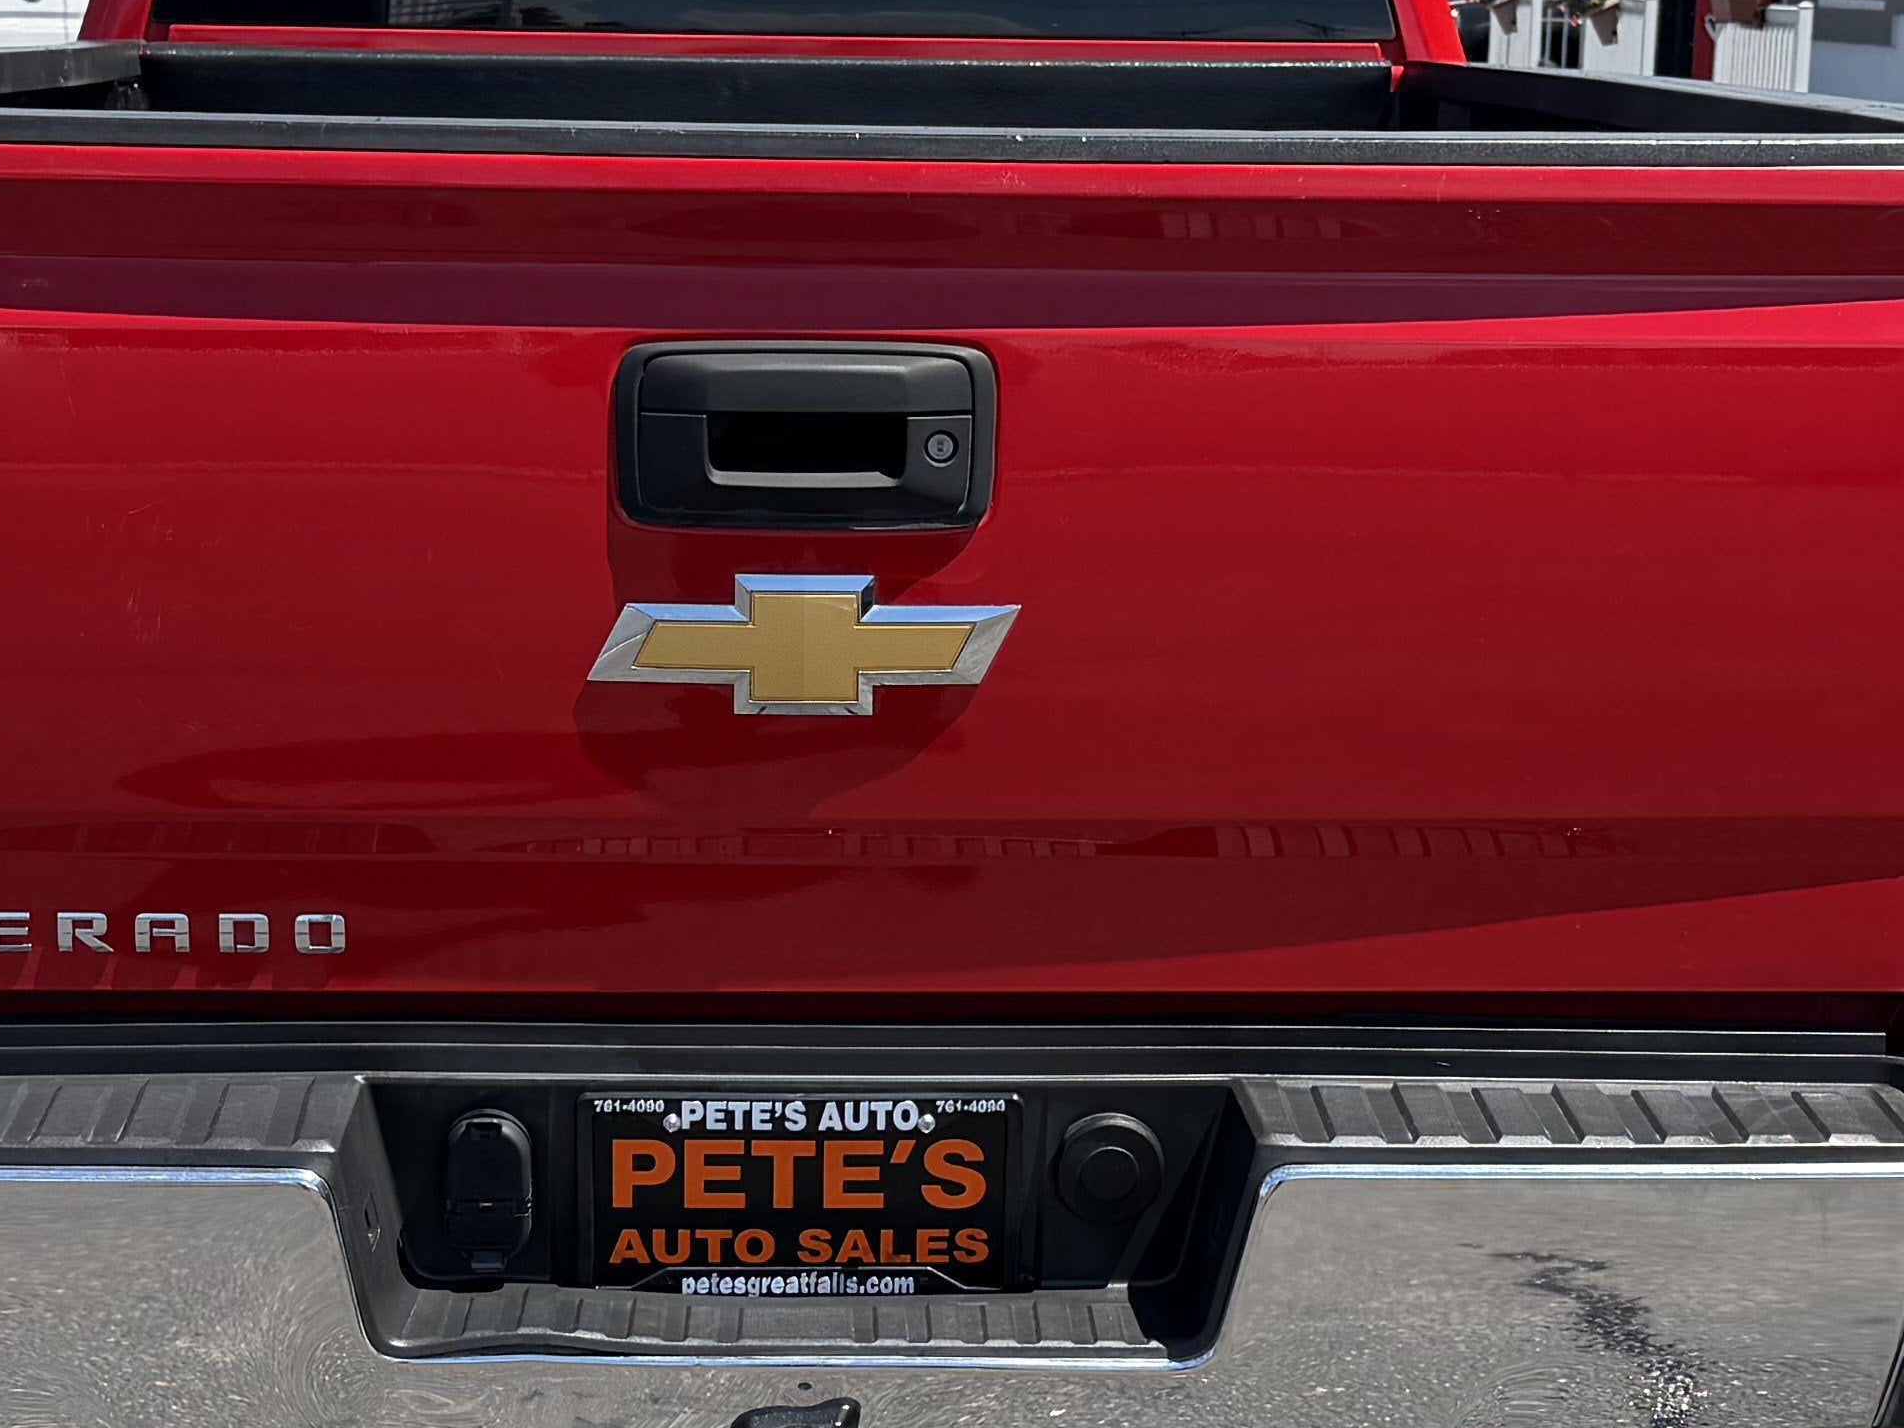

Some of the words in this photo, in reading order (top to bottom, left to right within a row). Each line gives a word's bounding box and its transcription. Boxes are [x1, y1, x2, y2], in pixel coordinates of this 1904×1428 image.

[681, 1100, 807, 1132] PETE'S
[818, 1099, 919, 1132] AUTO
[612, 1138, 987, 1209] PETE'S
[609, 1228, 776, 1264] AUTO
[796, 1228, 989, 1264] SALES
[681, 1272, 916, 1297] petesgreatfalls.com
